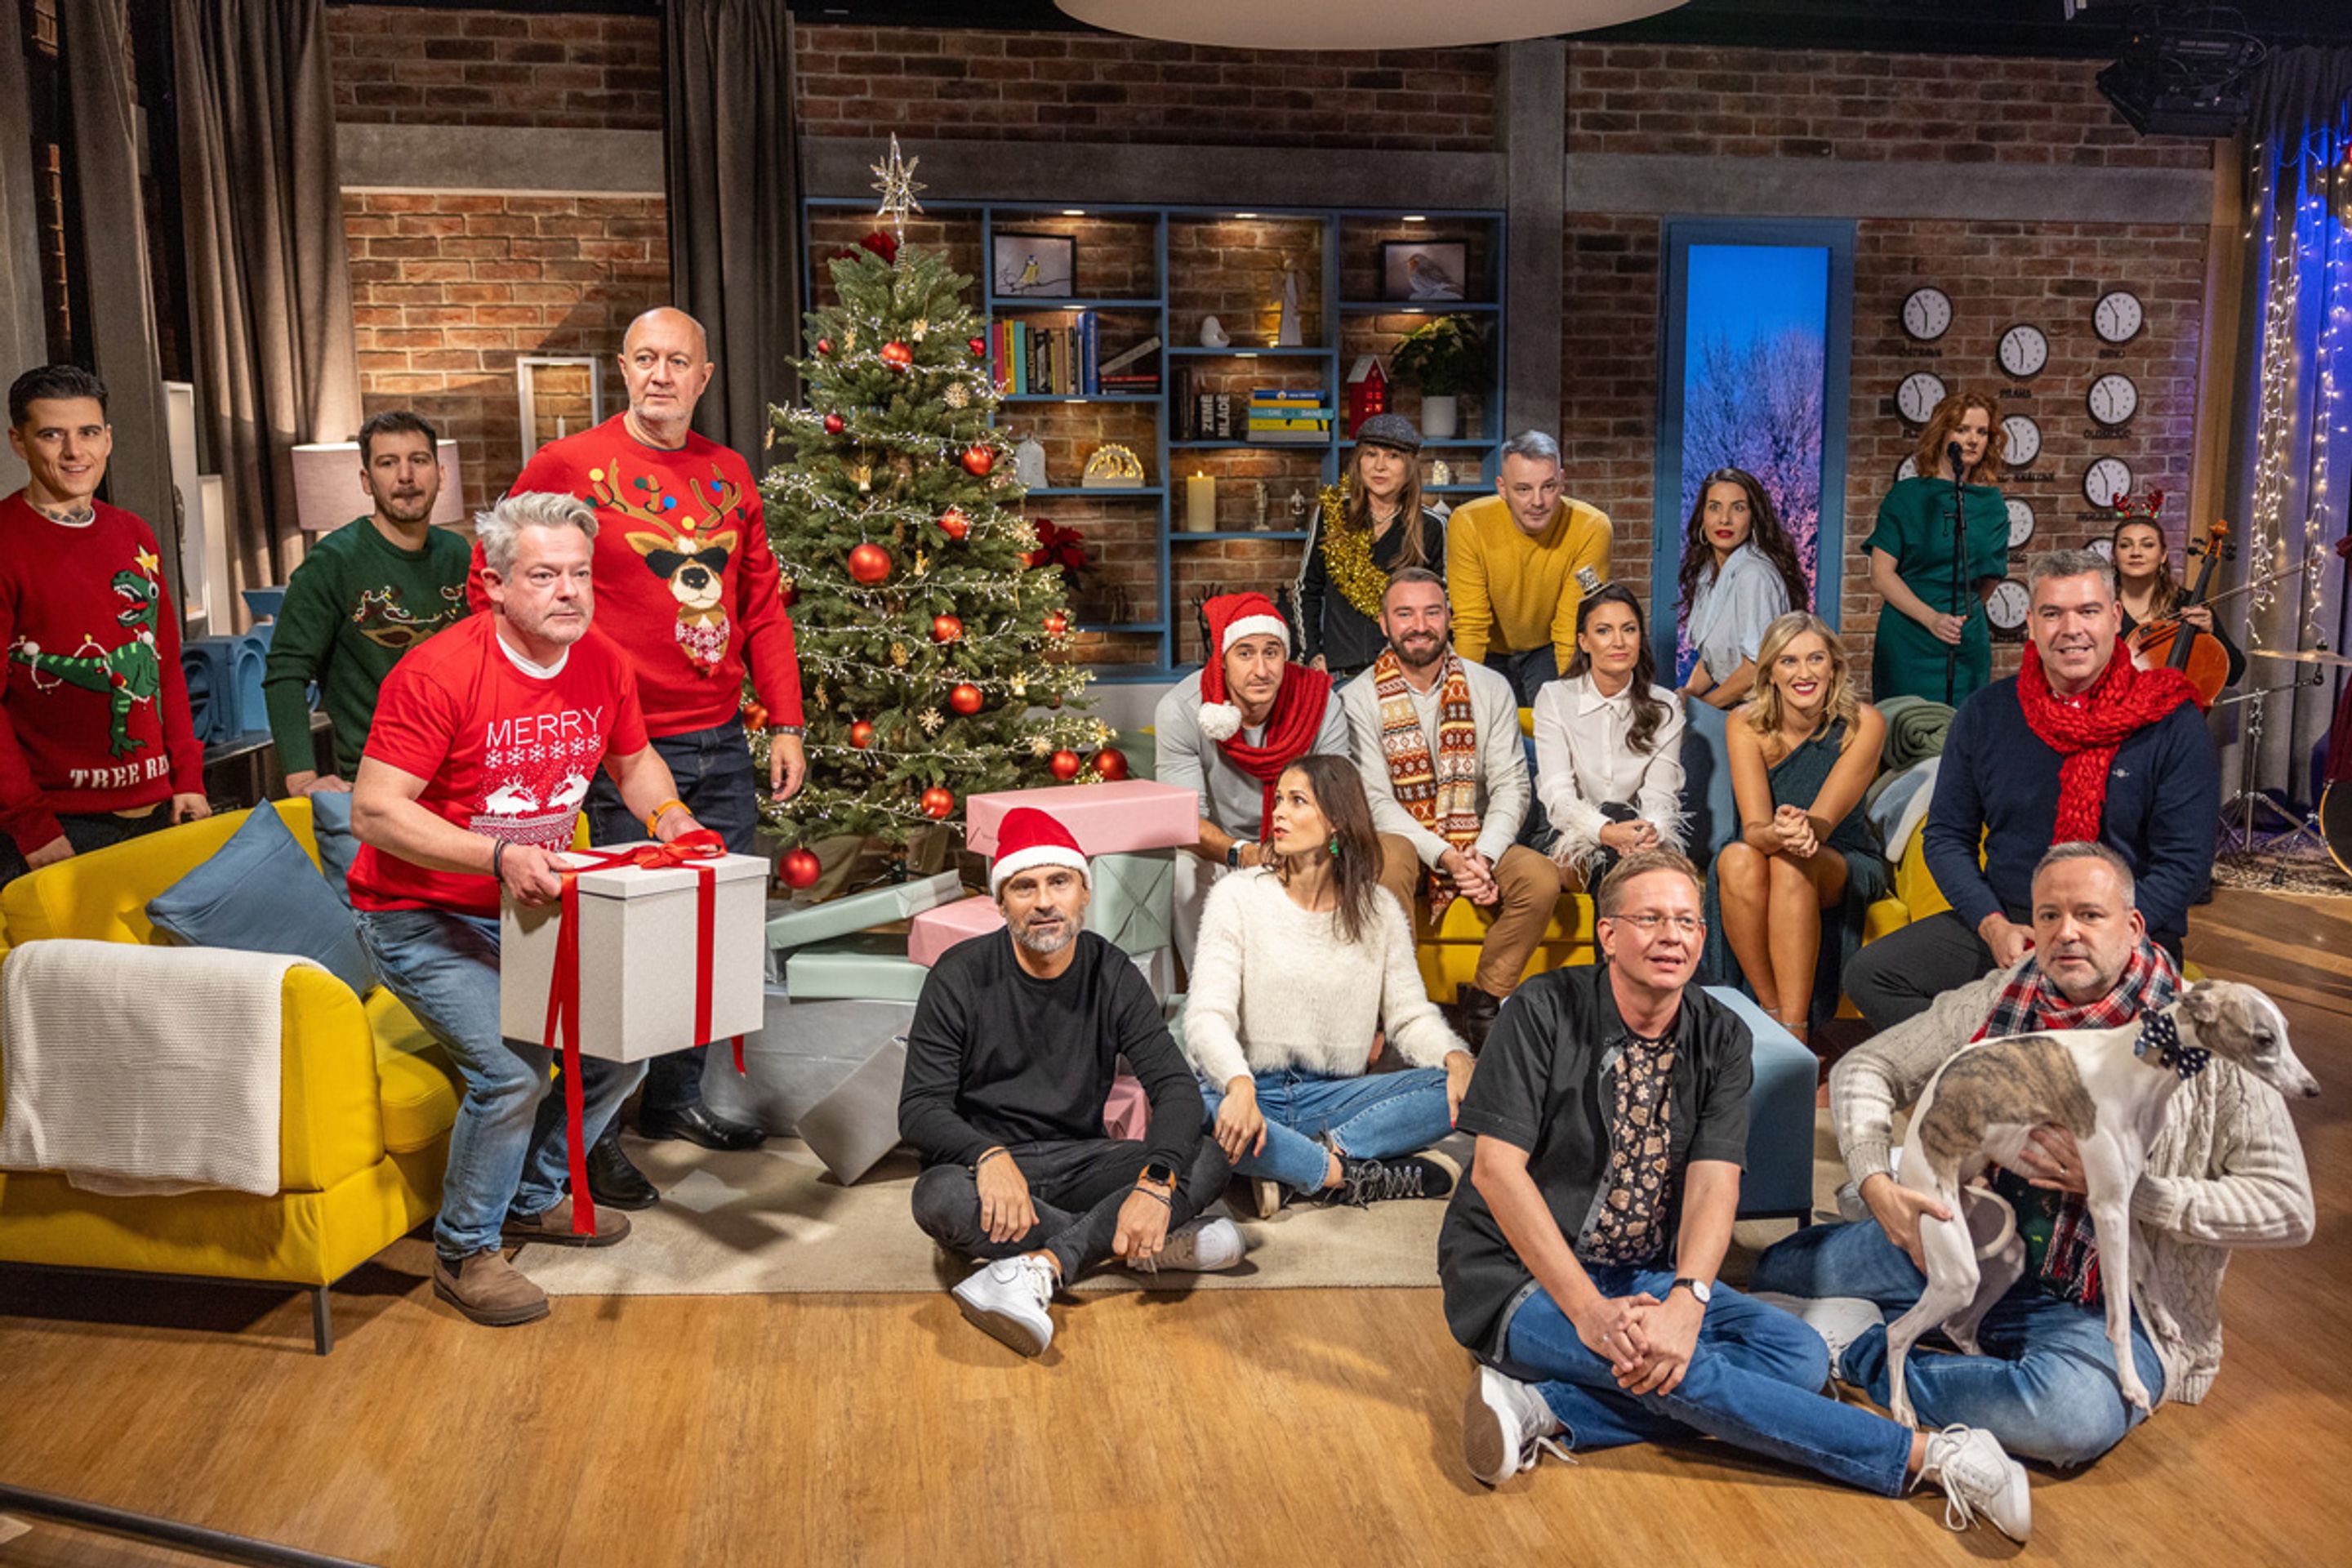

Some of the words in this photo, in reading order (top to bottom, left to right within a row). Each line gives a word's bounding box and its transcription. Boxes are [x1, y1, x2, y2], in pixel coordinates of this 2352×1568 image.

[486, 706, 603, 749] MERRY
[69, 763, 140, 789] TREE
[145, 754, 169, 779] RE
